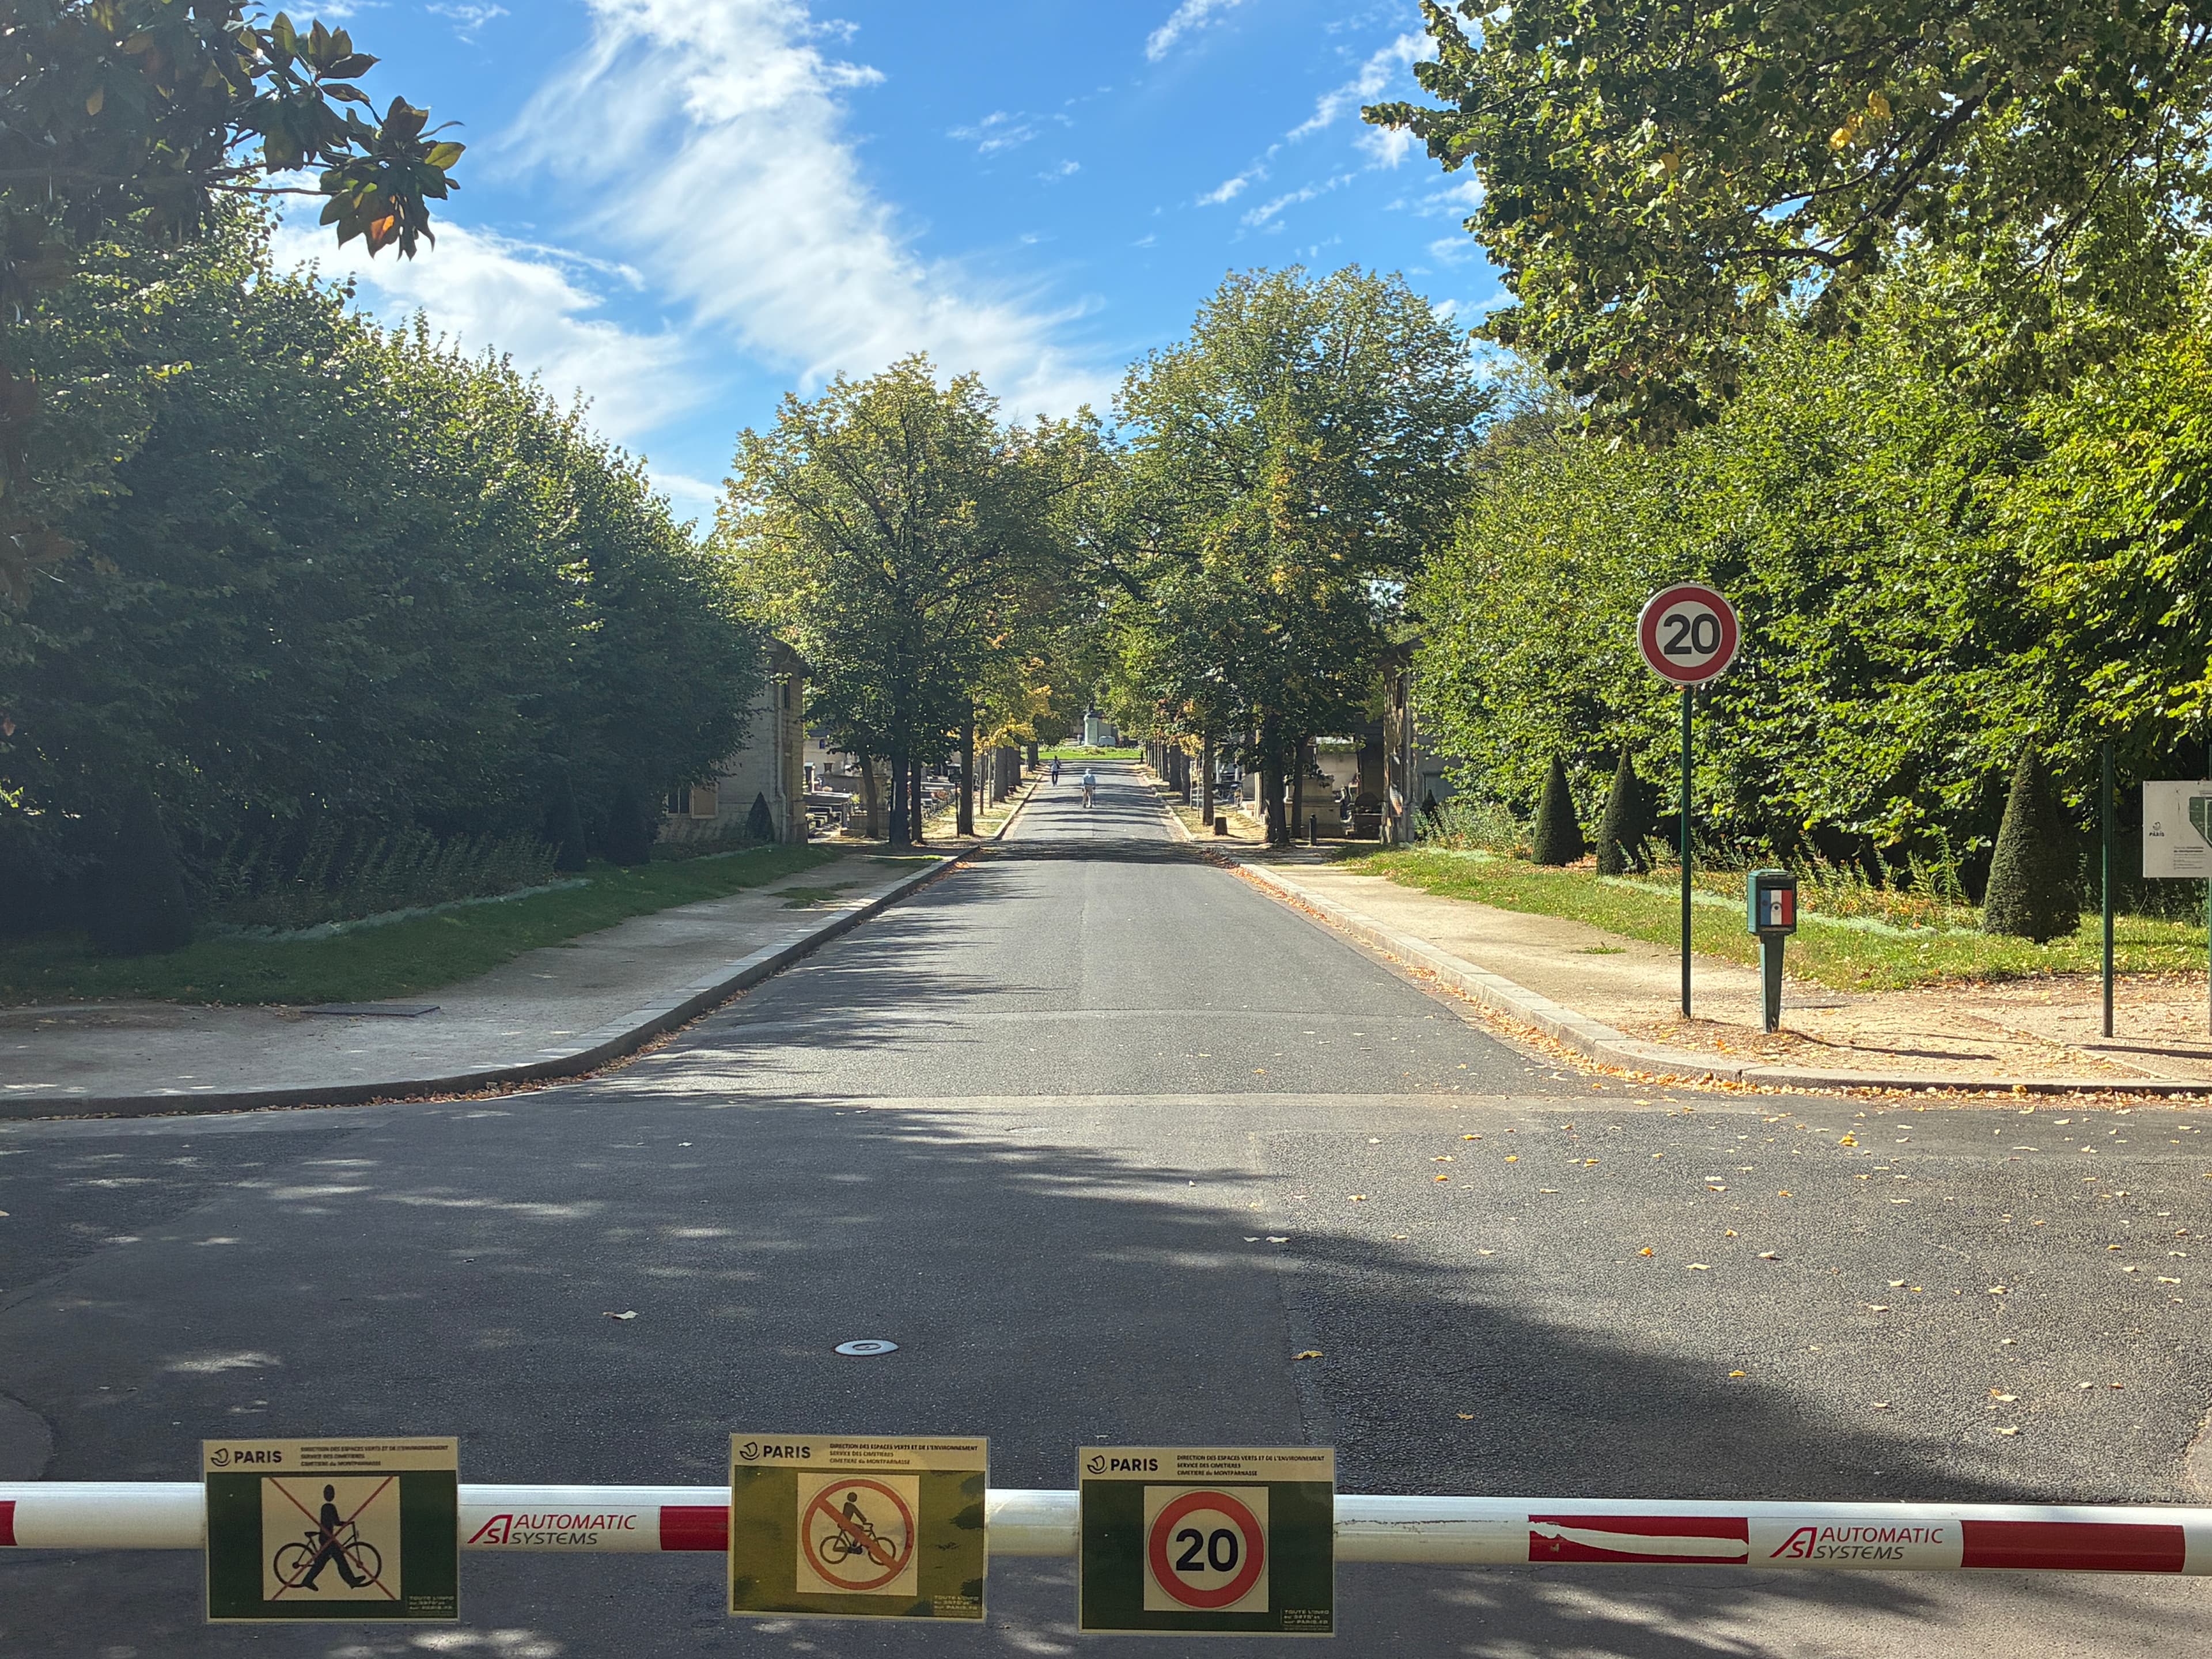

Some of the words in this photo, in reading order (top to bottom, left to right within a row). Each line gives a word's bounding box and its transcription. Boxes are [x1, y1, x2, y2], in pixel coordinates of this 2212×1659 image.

[1664, 613, 1721, 655] 20
[234, 1450, 282, 1463] PARIS
[763, 1445, 811, 1459] PARIS
[1111, 1459, 1158, 1471] PARIS
[514, 1514, 637, 1529] AUTOMATIC
[510, 1532, 598, 1544] SYSTEMS
[1819, 1527, 1944, 1543] AUTOMATIC
[1176, 1528, 1238, 1571] 20
[1813, 1546, 1904, 1559] SYSTEMS
